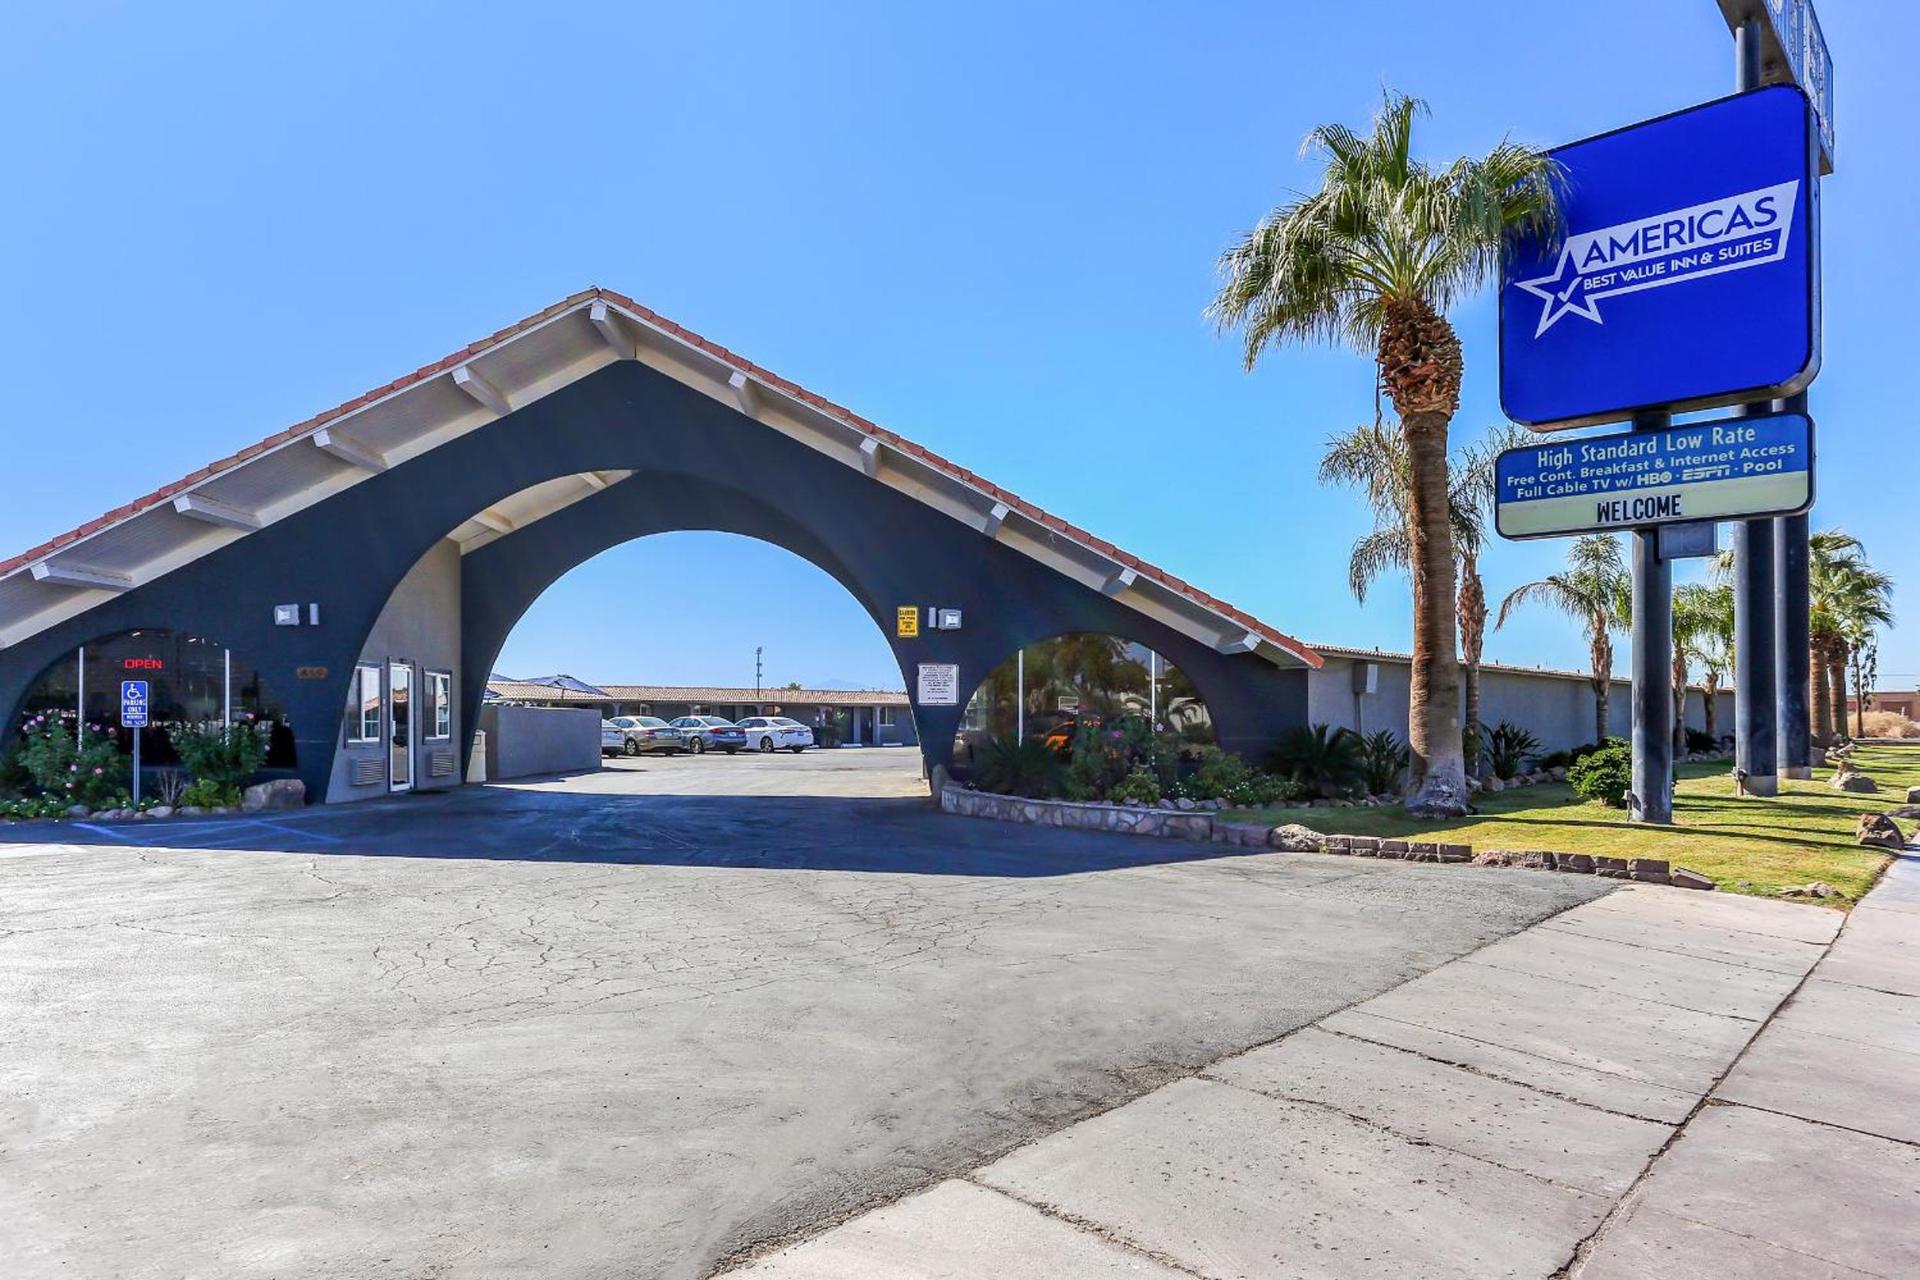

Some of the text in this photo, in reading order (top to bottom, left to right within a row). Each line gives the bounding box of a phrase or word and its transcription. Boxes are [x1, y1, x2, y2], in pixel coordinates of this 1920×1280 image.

[1581, 196, 1778, 268] AMERICAS
[1583, 237, 1773, 291] BEST VALUE INN & SUITES
[1507, 444, 1796, 487] Free Cont. Breakfast & Internet Access
[1537, 426, 1756, 470] High Standard Low Rate
[1517, 486, 1542, 499] Full
[1546, 481, 1588, 495] Cable
[1592, 478, 1611, 490] TV
[1636, 470, 1672, 486] HBO
[1682, 464, 1731, 481] ESPN
[1743, 458, 1783, 473] Pool
[1596, 493, 1682, 523] WELCOME
[123, 658, 163, 669] OPEN
